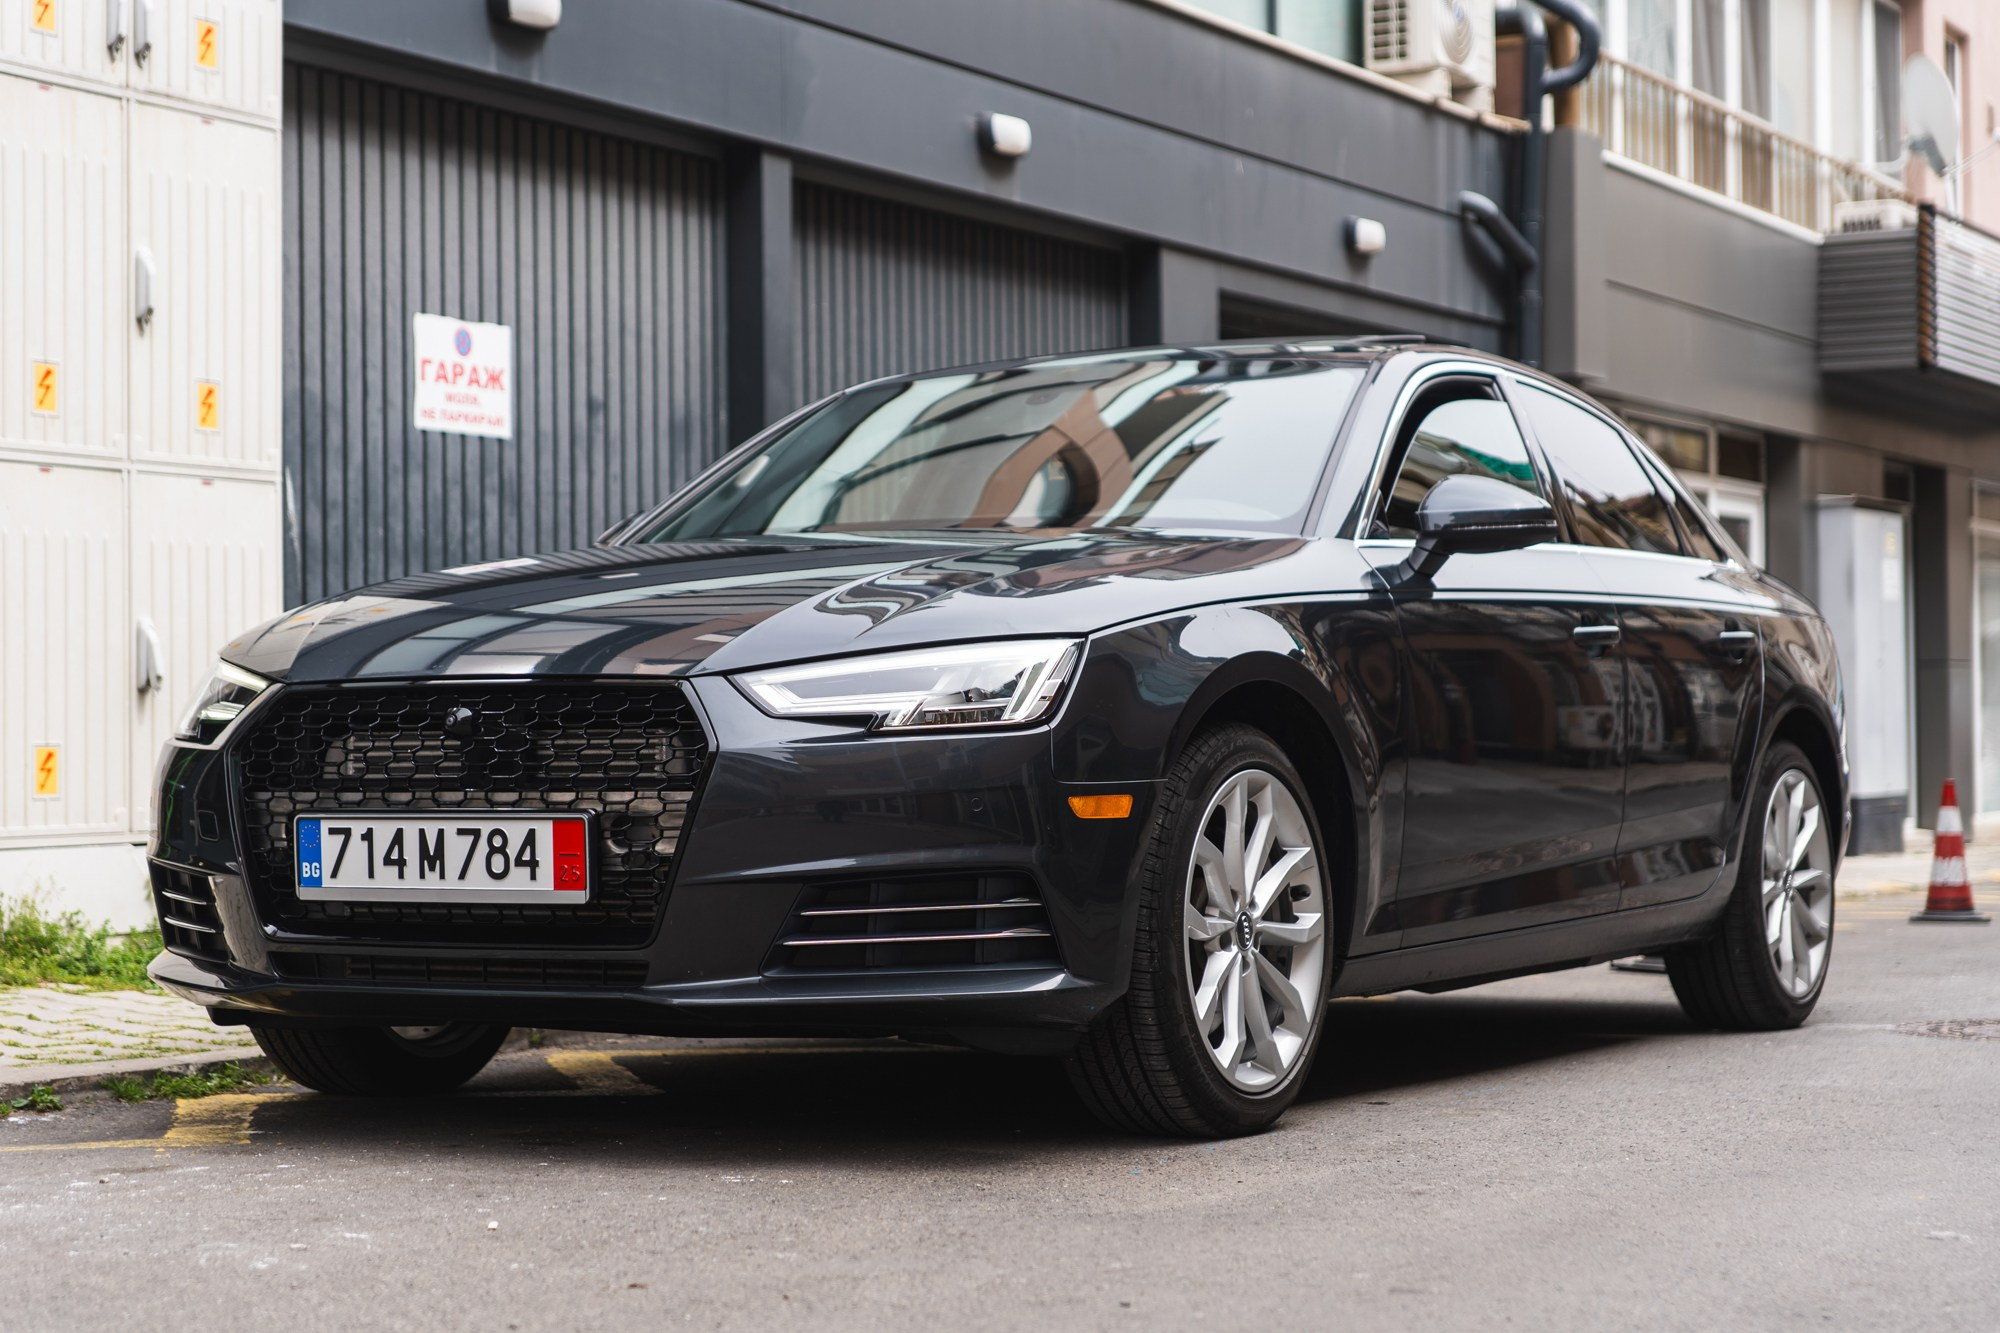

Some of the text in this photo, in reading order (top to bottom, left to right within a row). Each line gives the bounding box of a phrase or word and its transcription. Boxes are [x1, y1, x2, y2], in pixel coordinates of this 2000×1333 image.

[420, 358, 504, 391] ГАРАЖ
[302, 862, 320, 878] BG
[559, 864, 580, 882] 25
